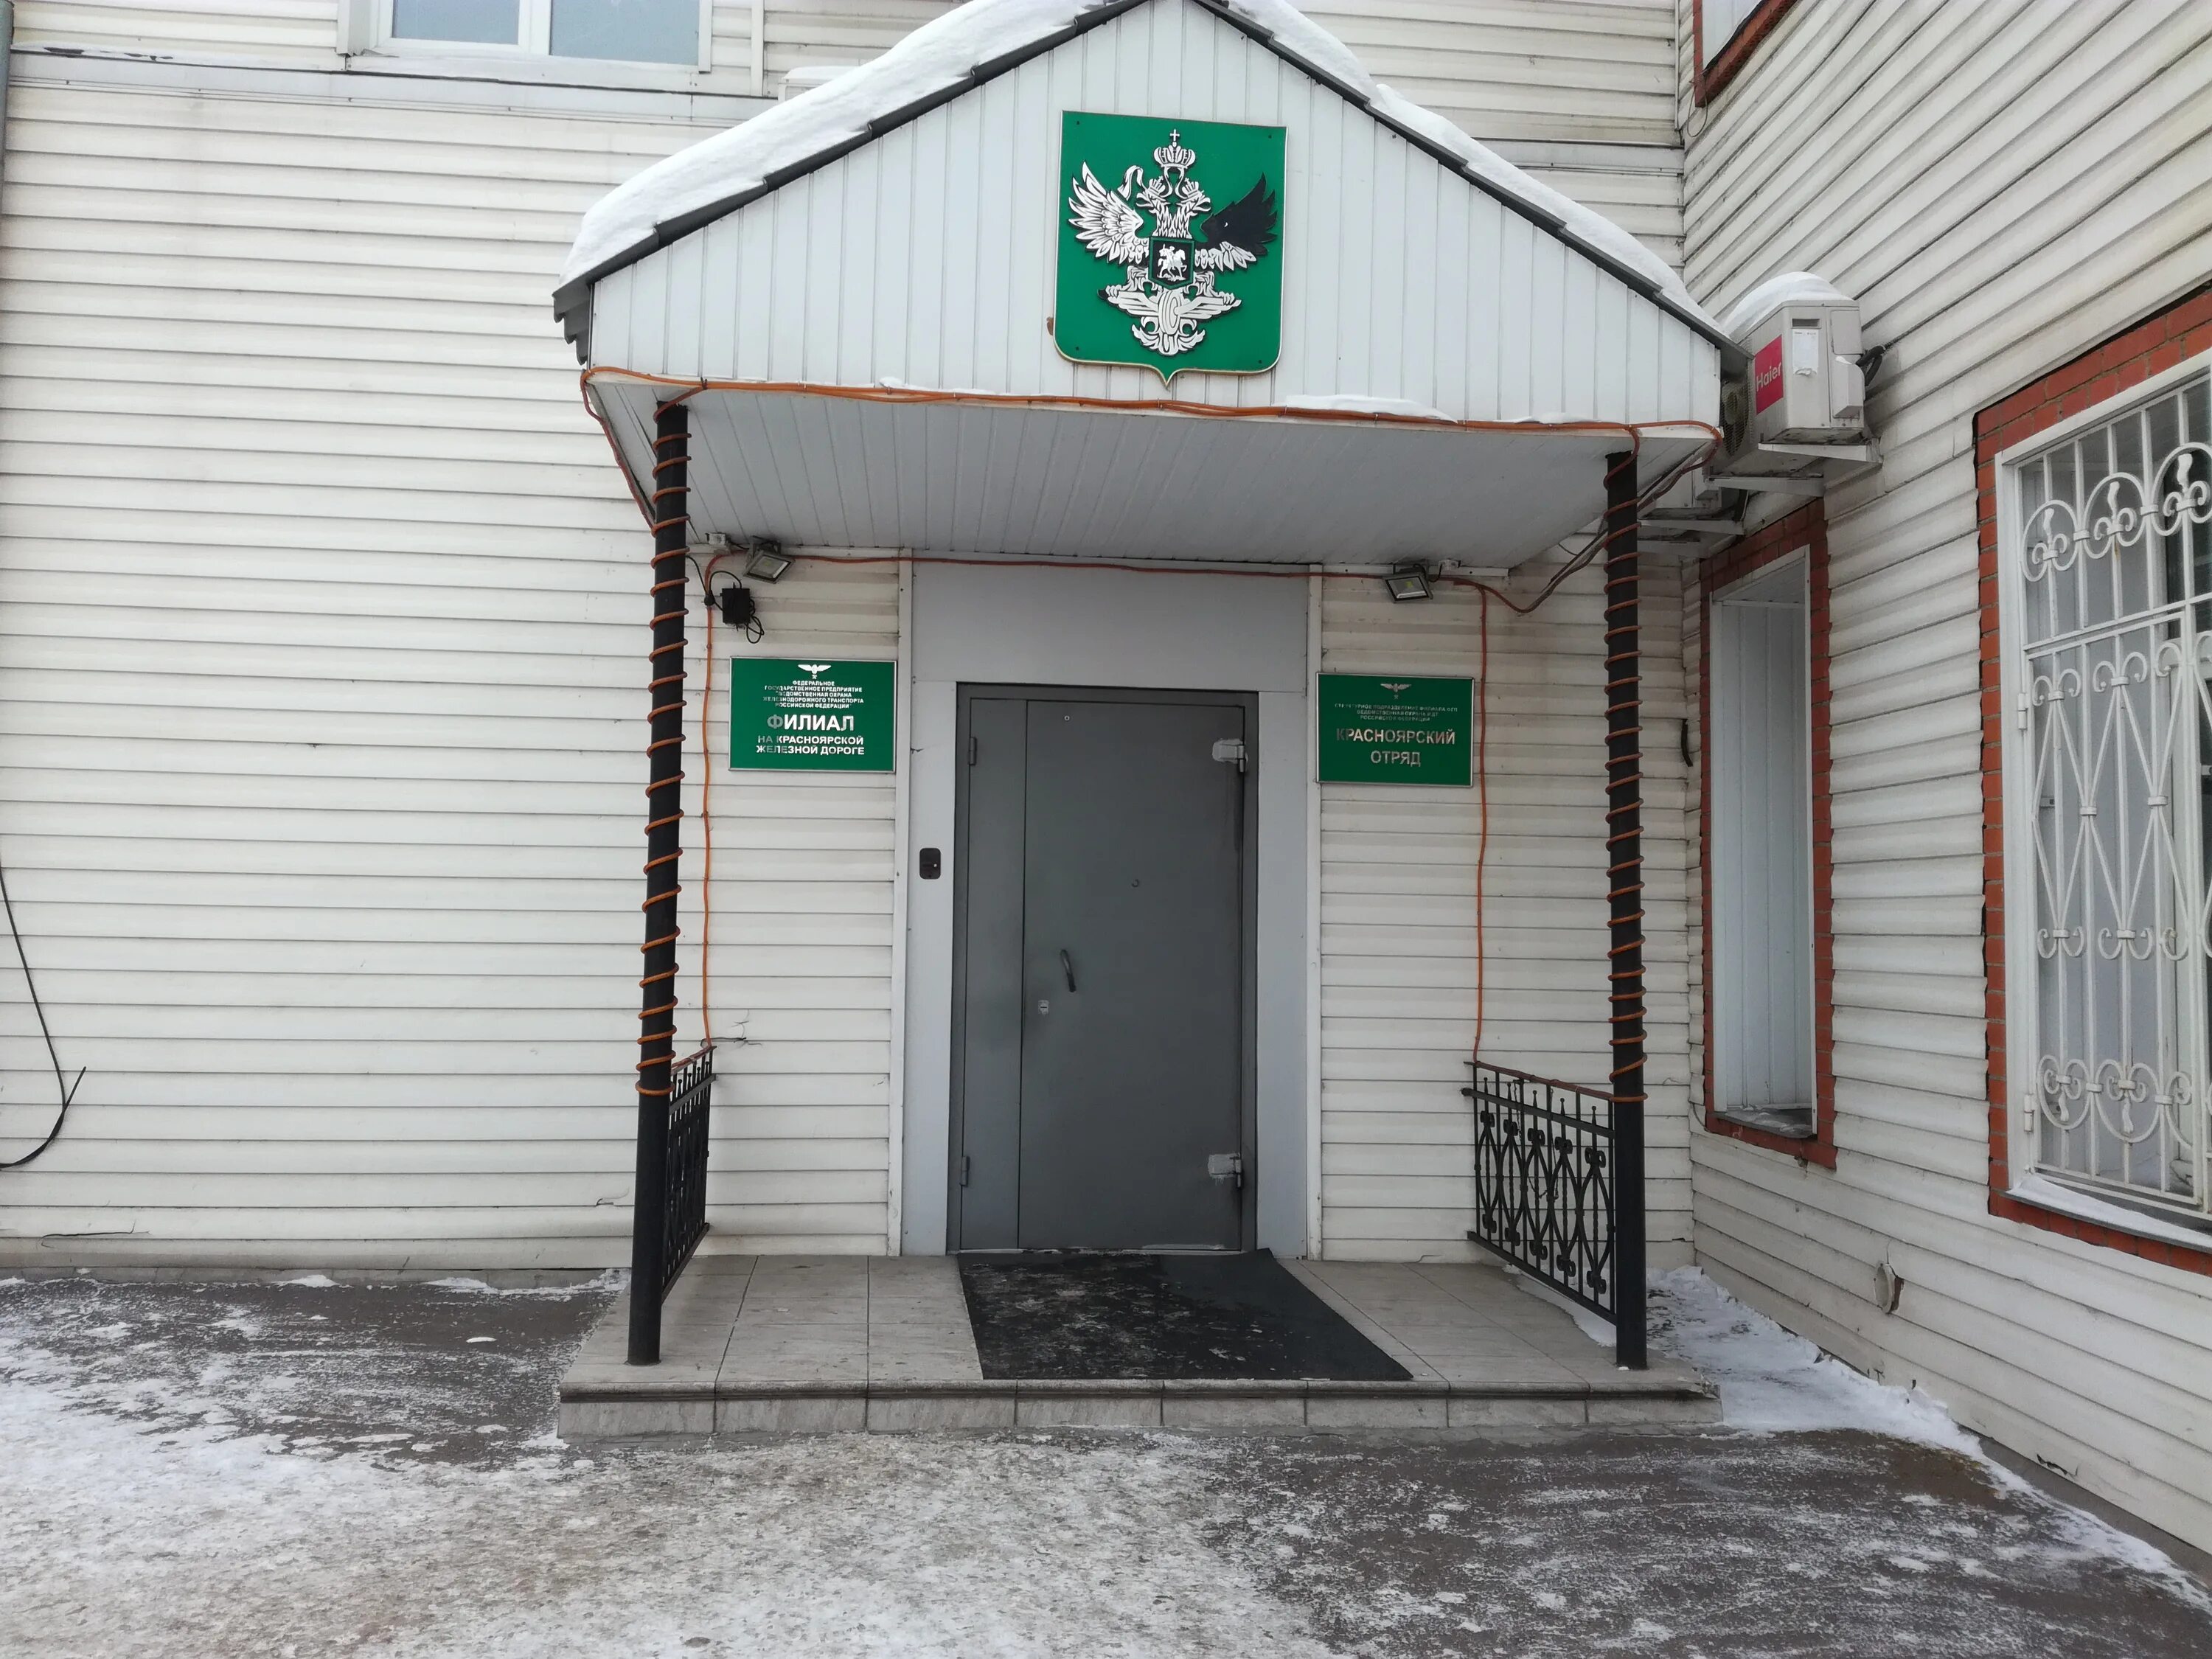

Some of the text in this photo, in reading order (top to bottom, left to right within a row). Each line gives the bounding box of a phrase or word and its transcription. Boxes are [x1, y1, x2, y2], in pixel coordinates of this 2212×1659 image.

[1756, 361, 1782, 392] Haier
[767, 714, 854, 731] ФИЛИАЛ
[758, 735, 863, 745] НА КРАСНОЯРСКОЙ
[1336, 728, 1455, 745] КРАСНОЯРСКИЙ
[756, 745, 865, 755] ЖЕЛЕЗНОЙ ДОРОГЕ
[1371, 750, 1421, 767] ОТРЯД
